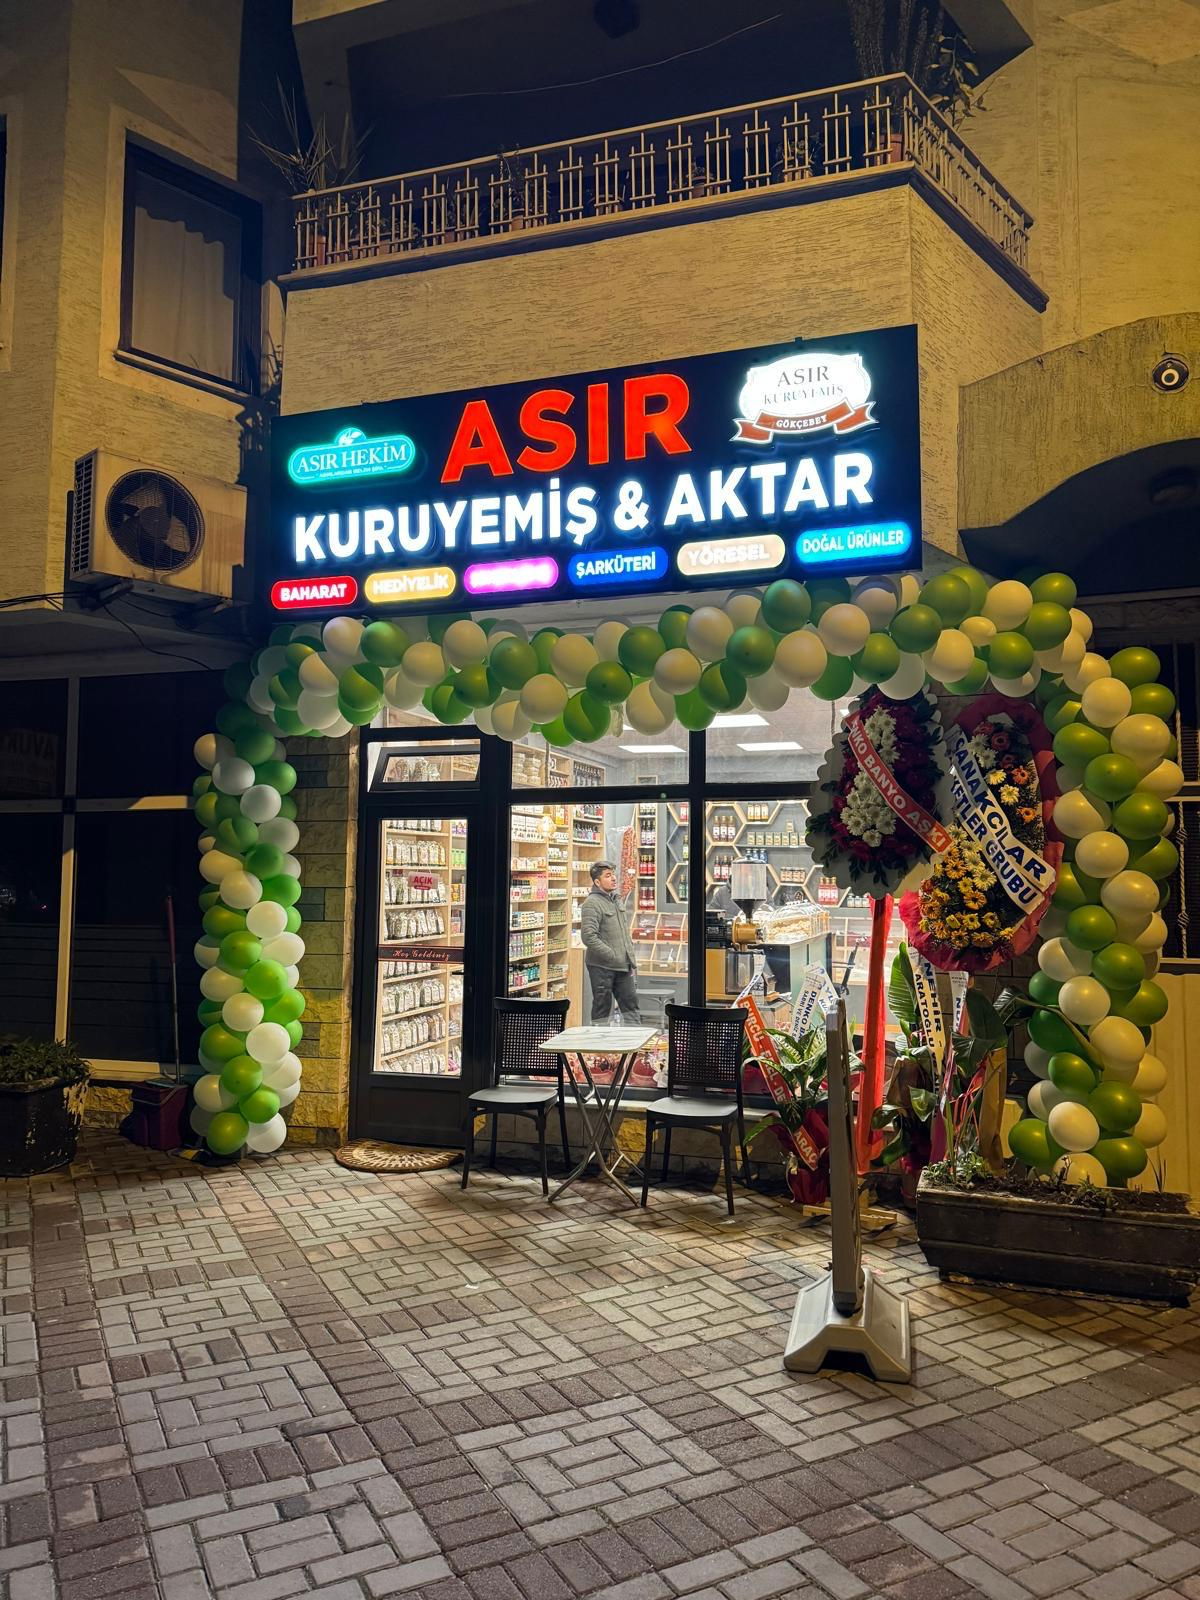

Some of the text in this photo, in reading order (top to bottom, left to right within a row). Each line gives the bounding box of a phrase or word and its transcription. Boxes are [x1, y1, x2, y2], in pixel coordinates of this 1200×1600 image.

[777, 365, 830, 388] ASIR
[441, 373, 692, 483] ASIR
[776, 414, 828, 429] GÖKÇEBEY
[297, 452, 339, 473] ASIR
[342, 442, 407, 468] HEKİM
[295, 452, 874, 562] KURUYEMİŞ & AKTAR
[688, 543, 770, 566] YÖRESEL
[803, 529, 904, 553] DOĞAL ÜRÜNLER
[576, 551, 656, 579] ŞARKÜTERİ
[280, 583, 347, 602] BAHARAT
[372, 572, 448, 595] HEDİYELİK
[864, 754, 906, 809] BANYO
[413, 875, 432, 885] AÇIK
[986, 839, 1037, 904] GRUBU
[801, 990, 817, 1025] DENKO
[915, 973, 935, 1047] ARATOĞLU
[924, 962, 942, 1032] NEHİR
